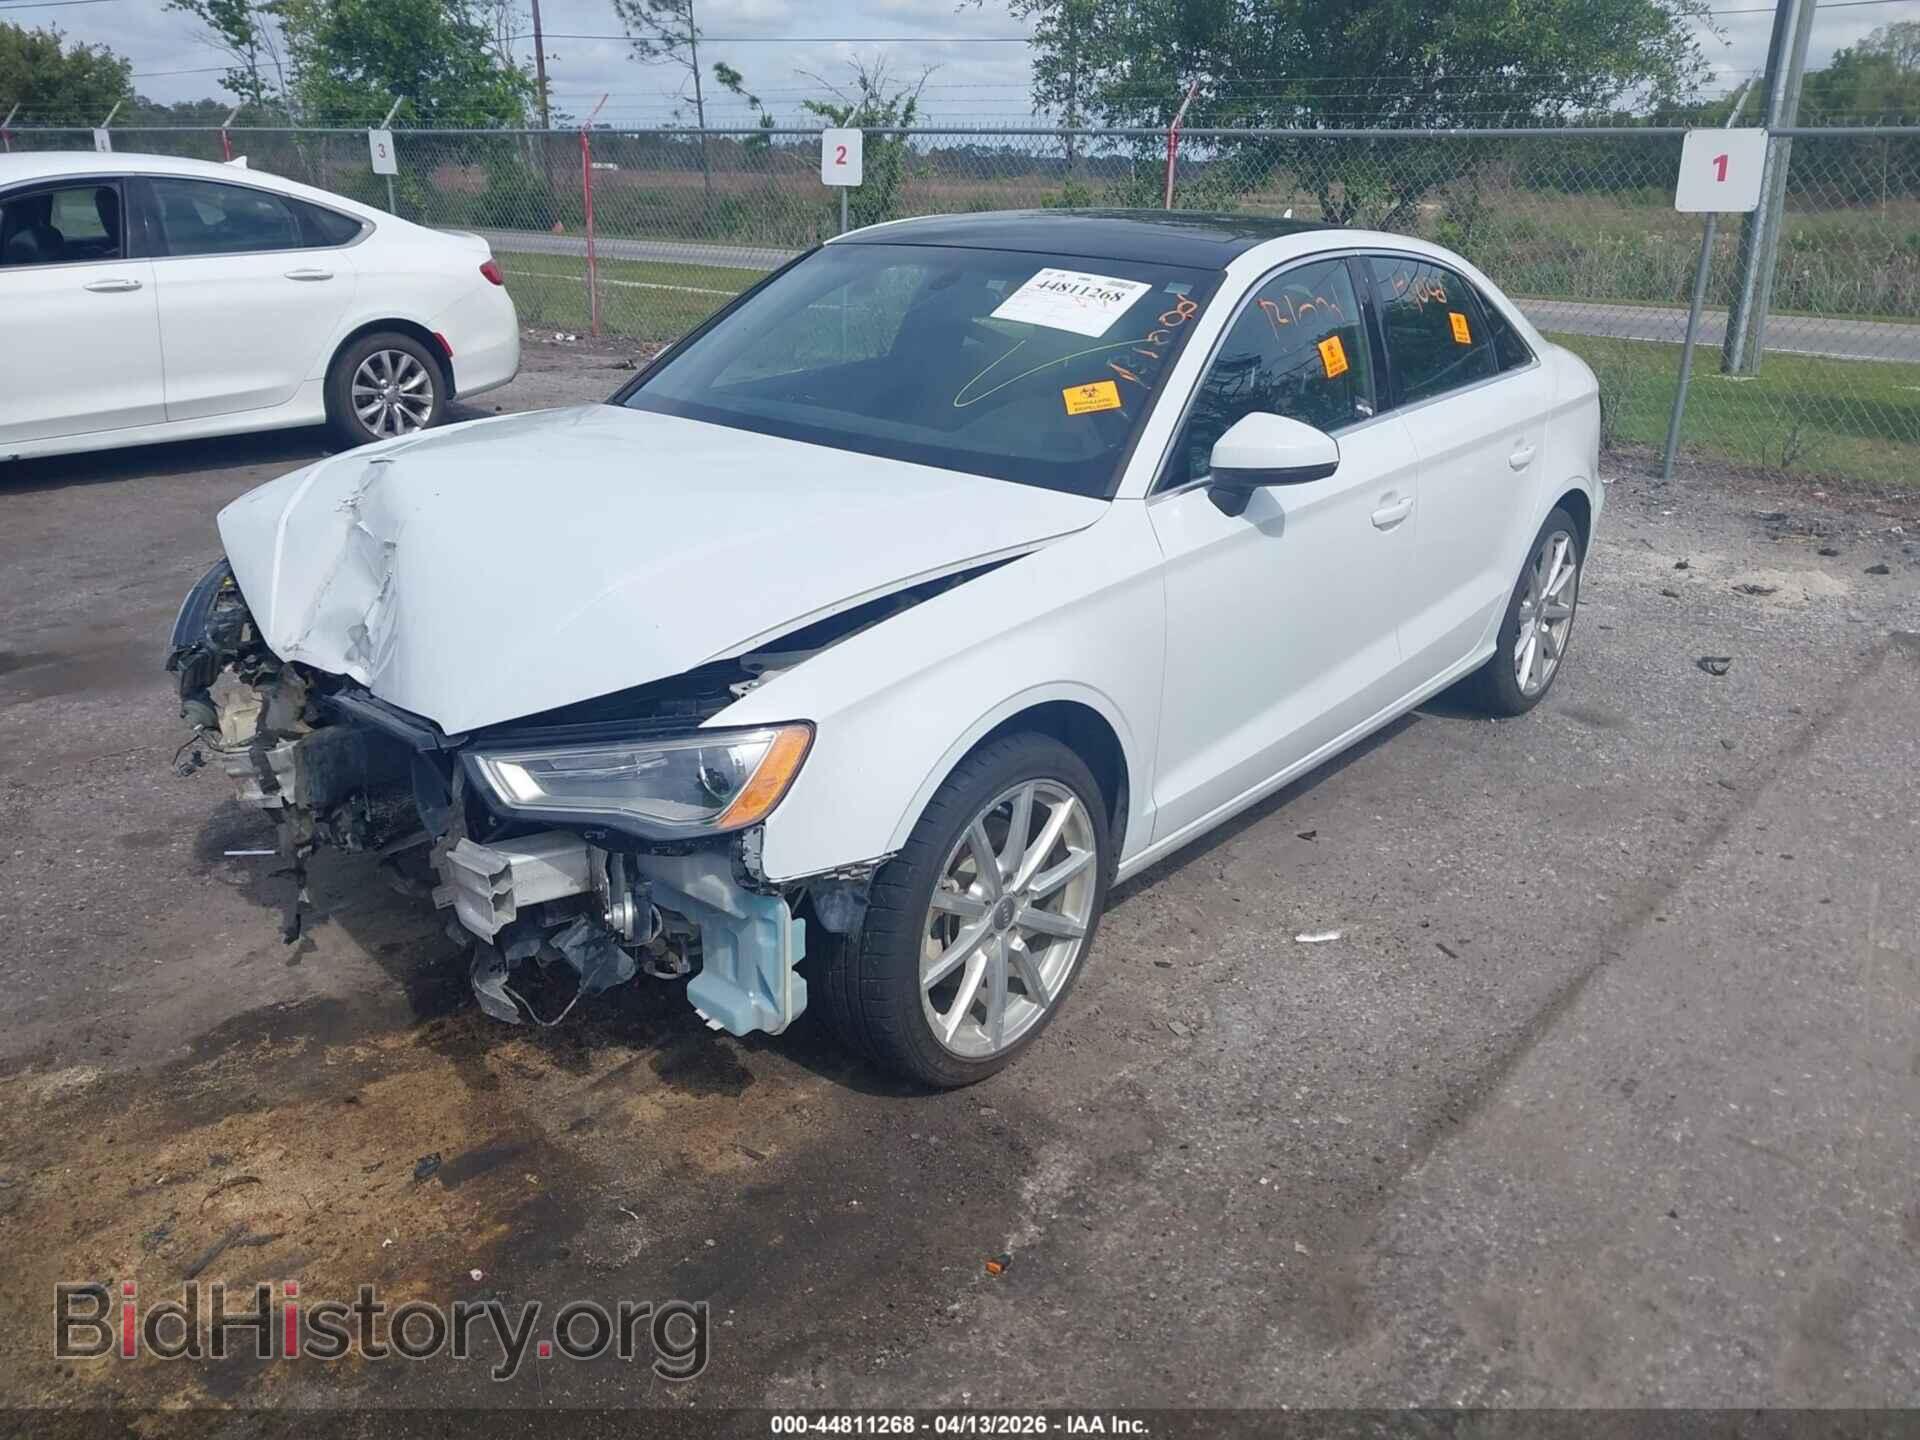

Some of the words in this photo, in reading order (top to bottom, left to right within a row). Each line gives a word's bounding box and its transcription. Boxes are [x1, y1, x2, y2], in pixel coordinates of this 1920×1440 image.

[378, 143, 386, 159] 3
[836, 145, 847, 165] 2
[1713, 154, 1728, 182] 1
[1037, 279, 1126, 302] 44811268
